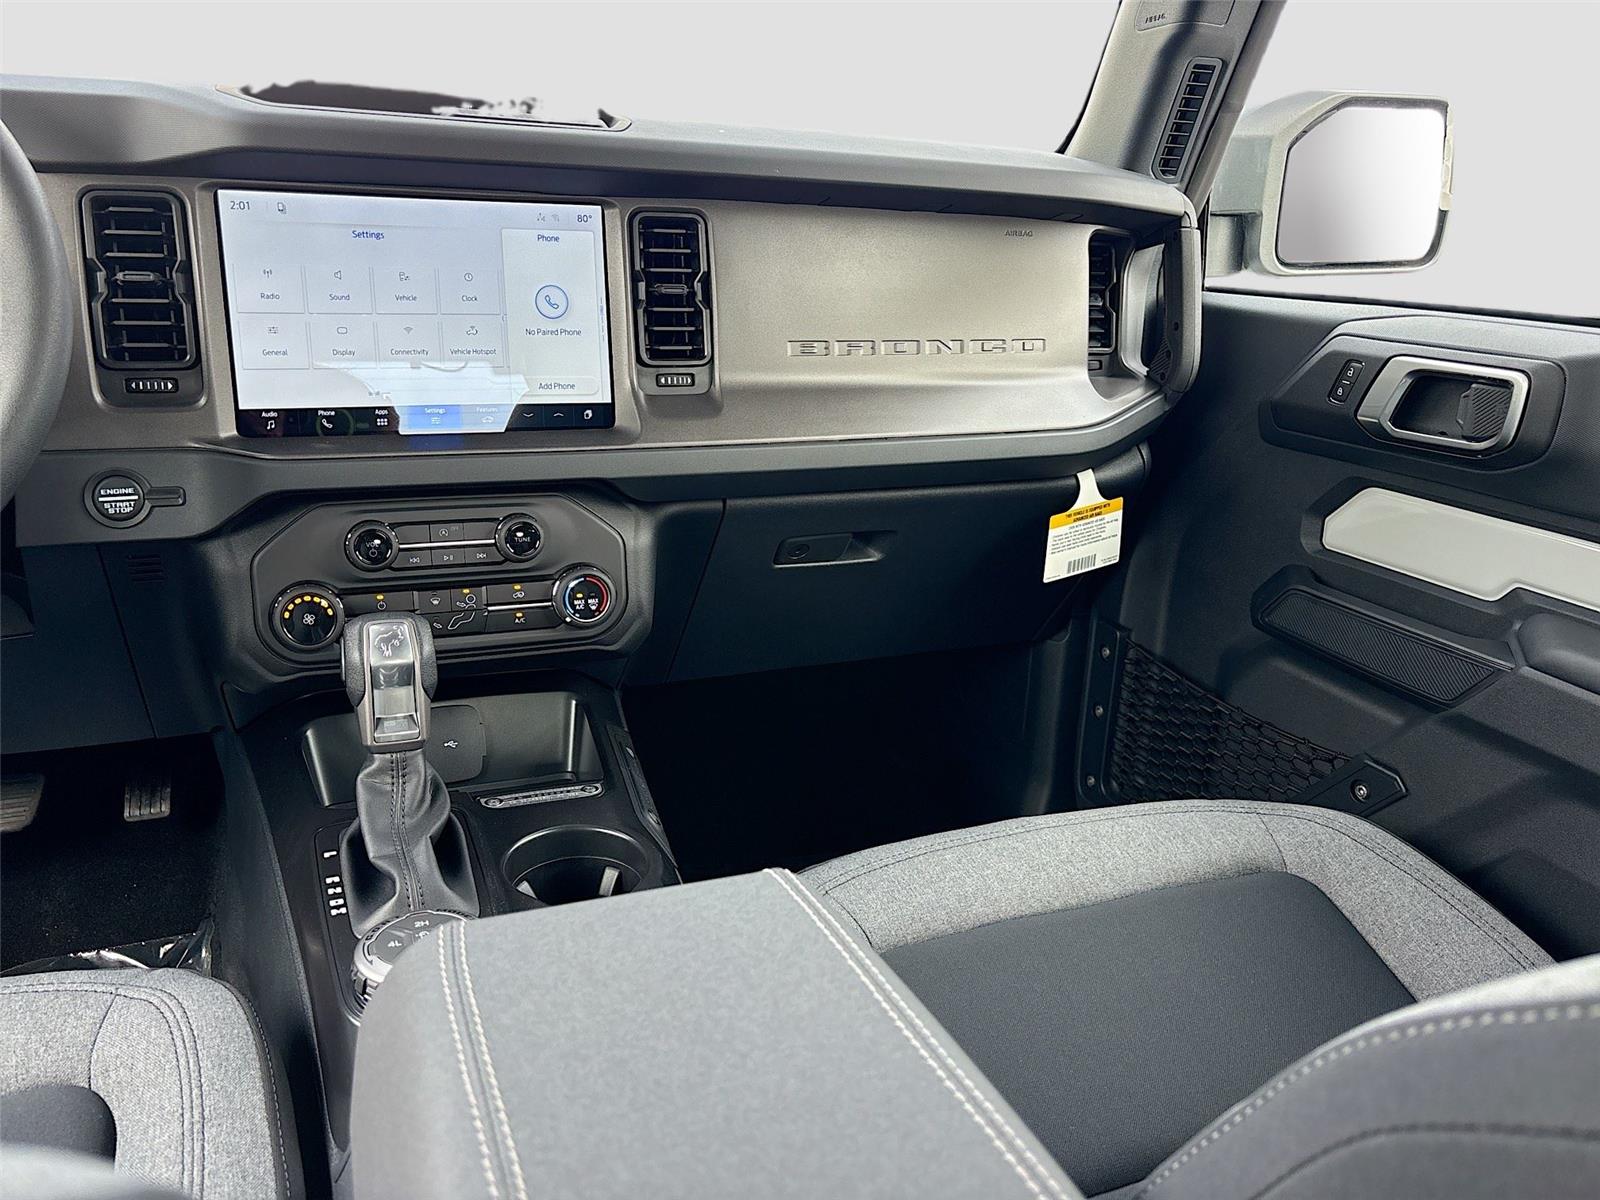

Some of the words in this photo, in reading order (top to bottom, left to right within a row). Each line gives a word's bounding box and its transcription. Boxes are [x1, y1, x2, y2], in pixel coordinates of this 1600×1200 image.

[230, 201, 250, 210] 2:01
[352, 230, 384, 240] Settings
[537, 234, 560, 243] Phone
[525, 328, 535, 336] No
[537, 328, 559, 336] Paired
[560, 328, 582, 336] Phone
[787, 338, 1046, 357] BRONCO
[332, 349, 355, 357] Display
[390, 348, 429, 357] Connectivity
[472, 348, 496, 356] Hotspot
[538, 382, 552, 390] Add
[553, 382, 576, 390] Phone
[261, 410, 278, 418] Audio
[317, 409, 336, 417] Phone
[424, 407, 446, 415] Settings
[327, 886, 343, 895] N
[330, 907, 347, 916] M
[414, 920, 430, 928] 2H
[388, 940, 402, 948] 4L
